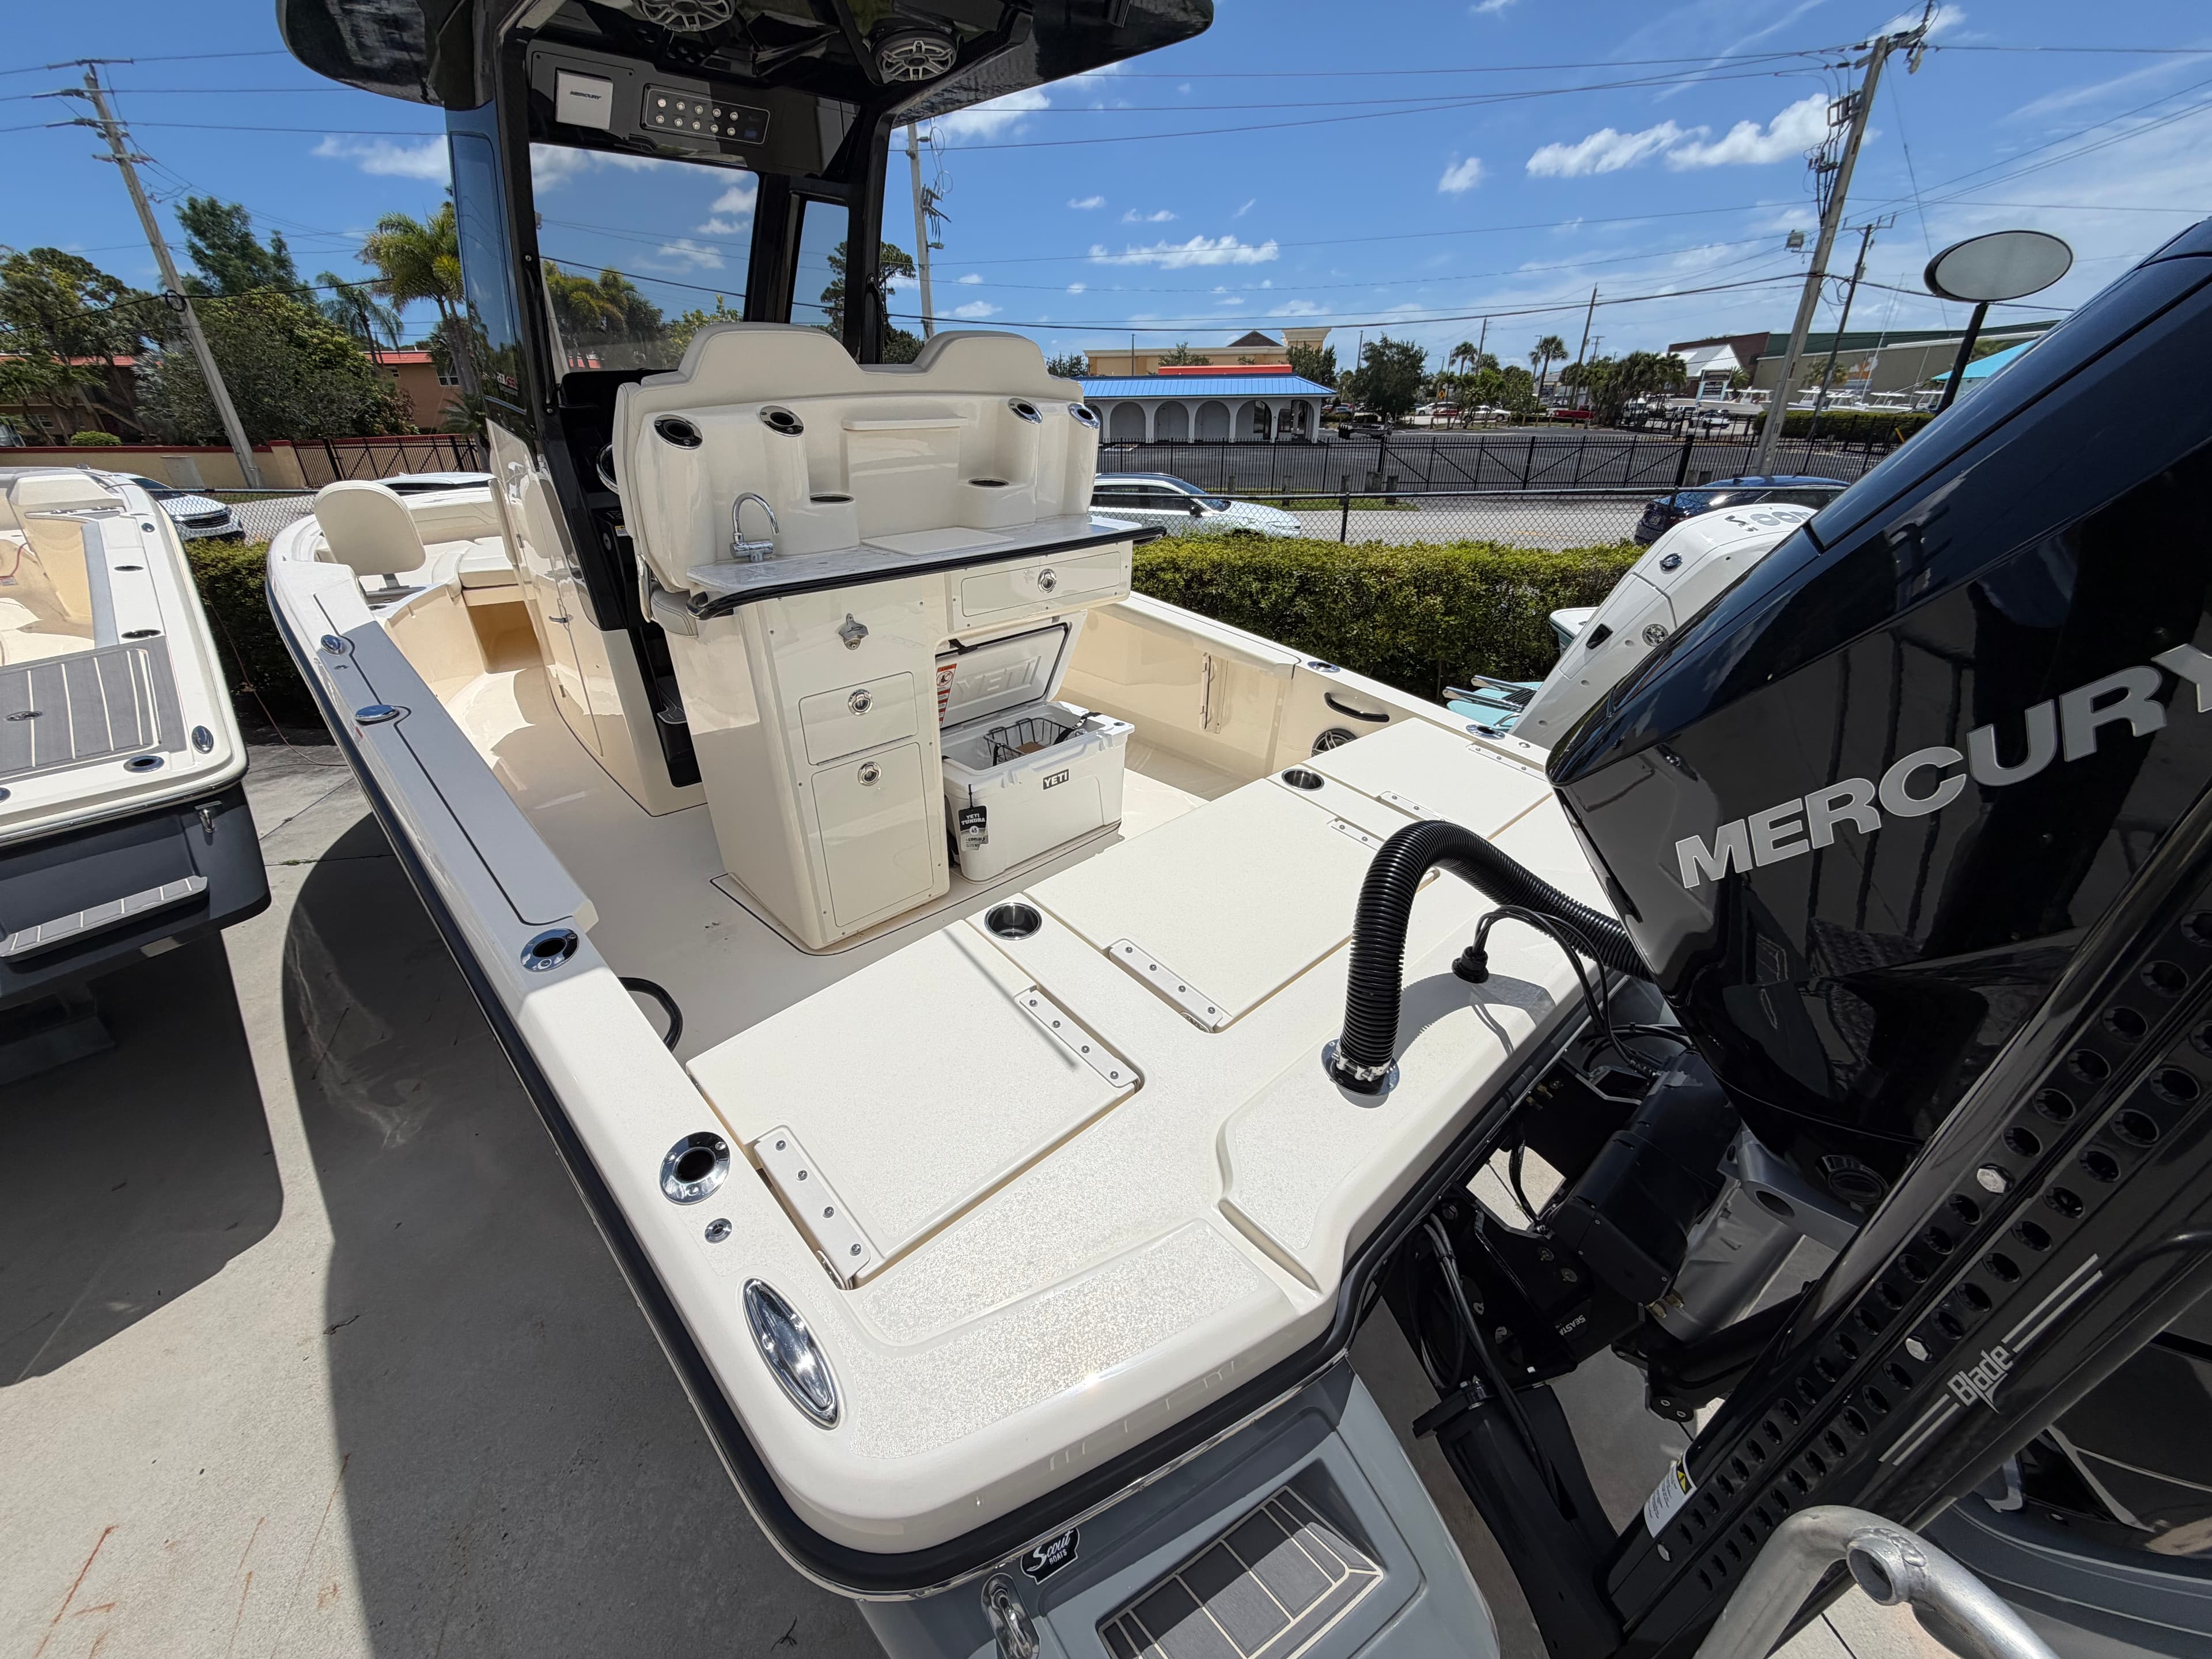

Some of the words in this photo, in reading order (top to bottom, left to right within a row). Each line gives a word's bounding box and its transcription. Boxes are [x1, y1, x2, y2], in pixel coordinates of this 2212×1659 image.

[956, 655, 1041, 704] YETI
[1044, 771, 1067, 787] YETI
[961, 817, 986, 825] TUNDRA
[1559, 1315, 1586, 1336] SEASTA
[1947, 1345, 2014, 1414] Blade
[1027, 1530, 1074, 1571] Scout
[1049, 1548, 1067, 1565] BOATS
